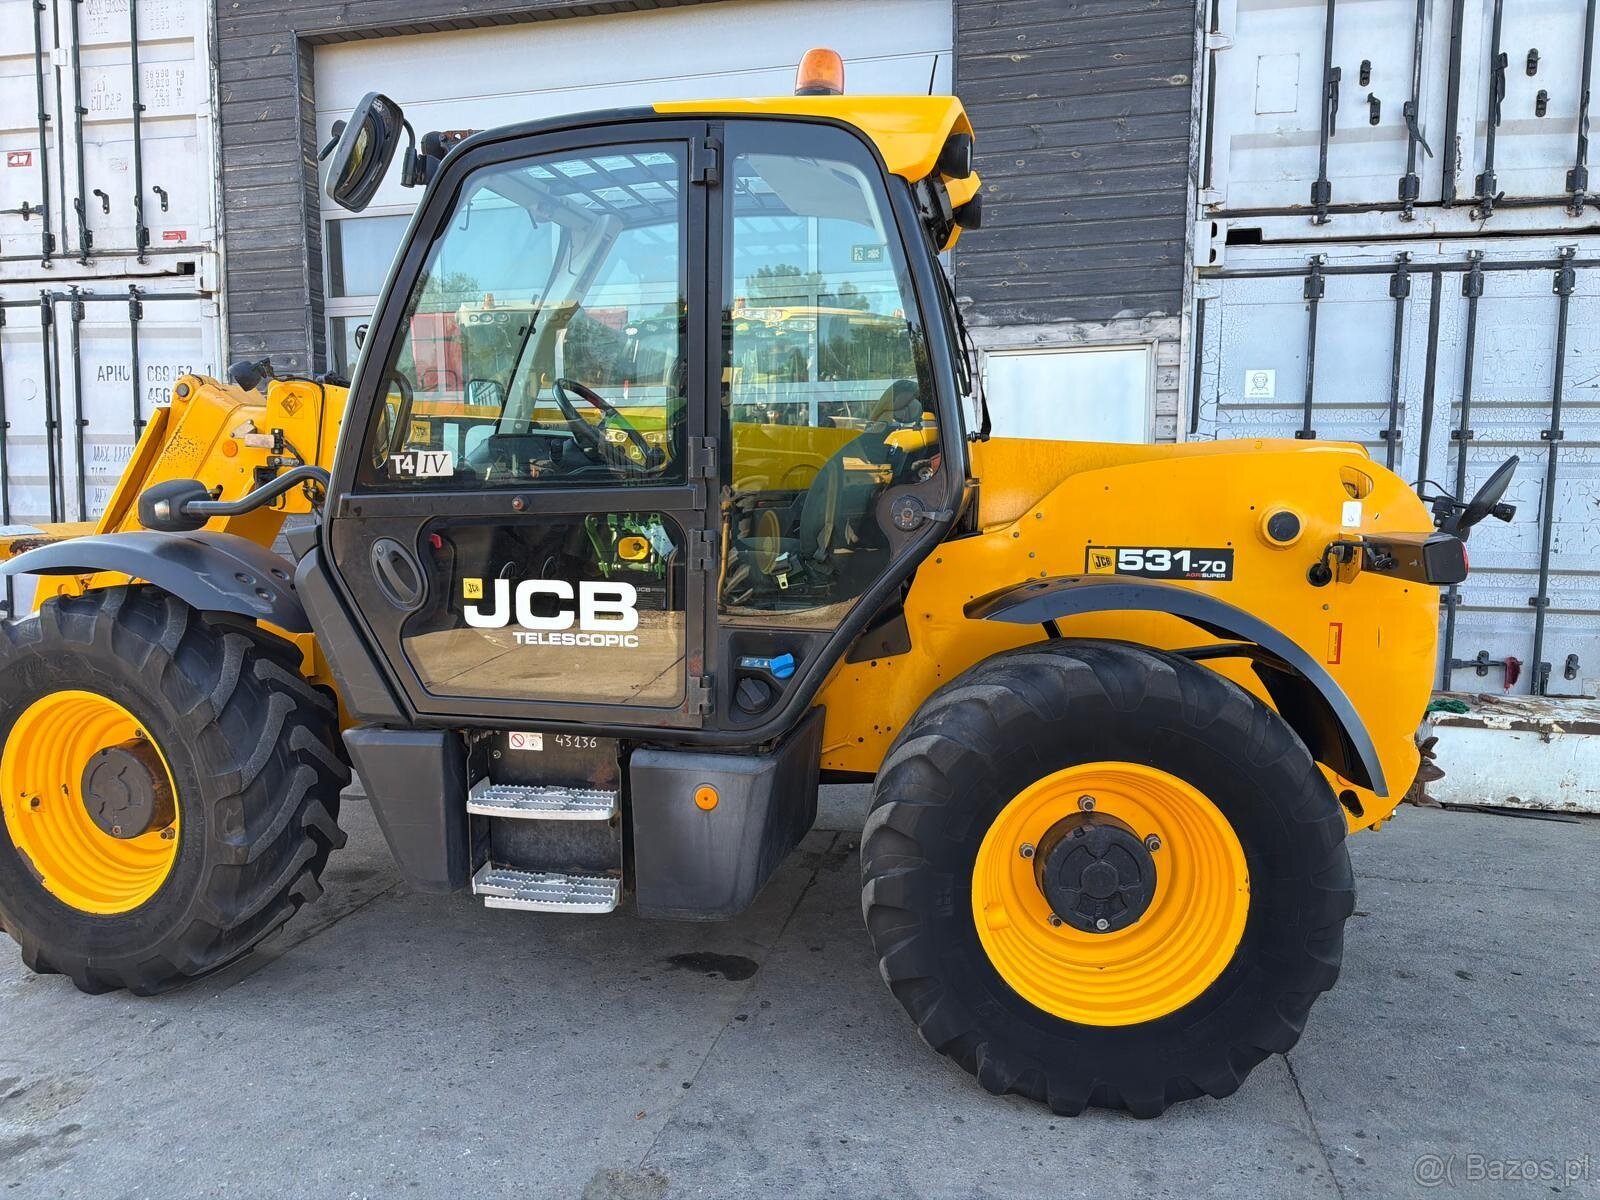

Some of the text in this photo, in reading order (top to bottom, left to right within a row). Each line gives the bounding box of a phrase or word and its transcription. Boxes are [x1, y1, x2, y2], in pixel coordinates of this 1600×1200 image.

[97, 365, 130, 382] APHU
[147, 387, 171, 403] 45G
[390, 453, 449, 474] T4 IV
[1095, 549, 1226, 572] JCB 531-70
[463, 578, 639, 632] JCB
[512, 631, 639, 649] TELESCOPIC
